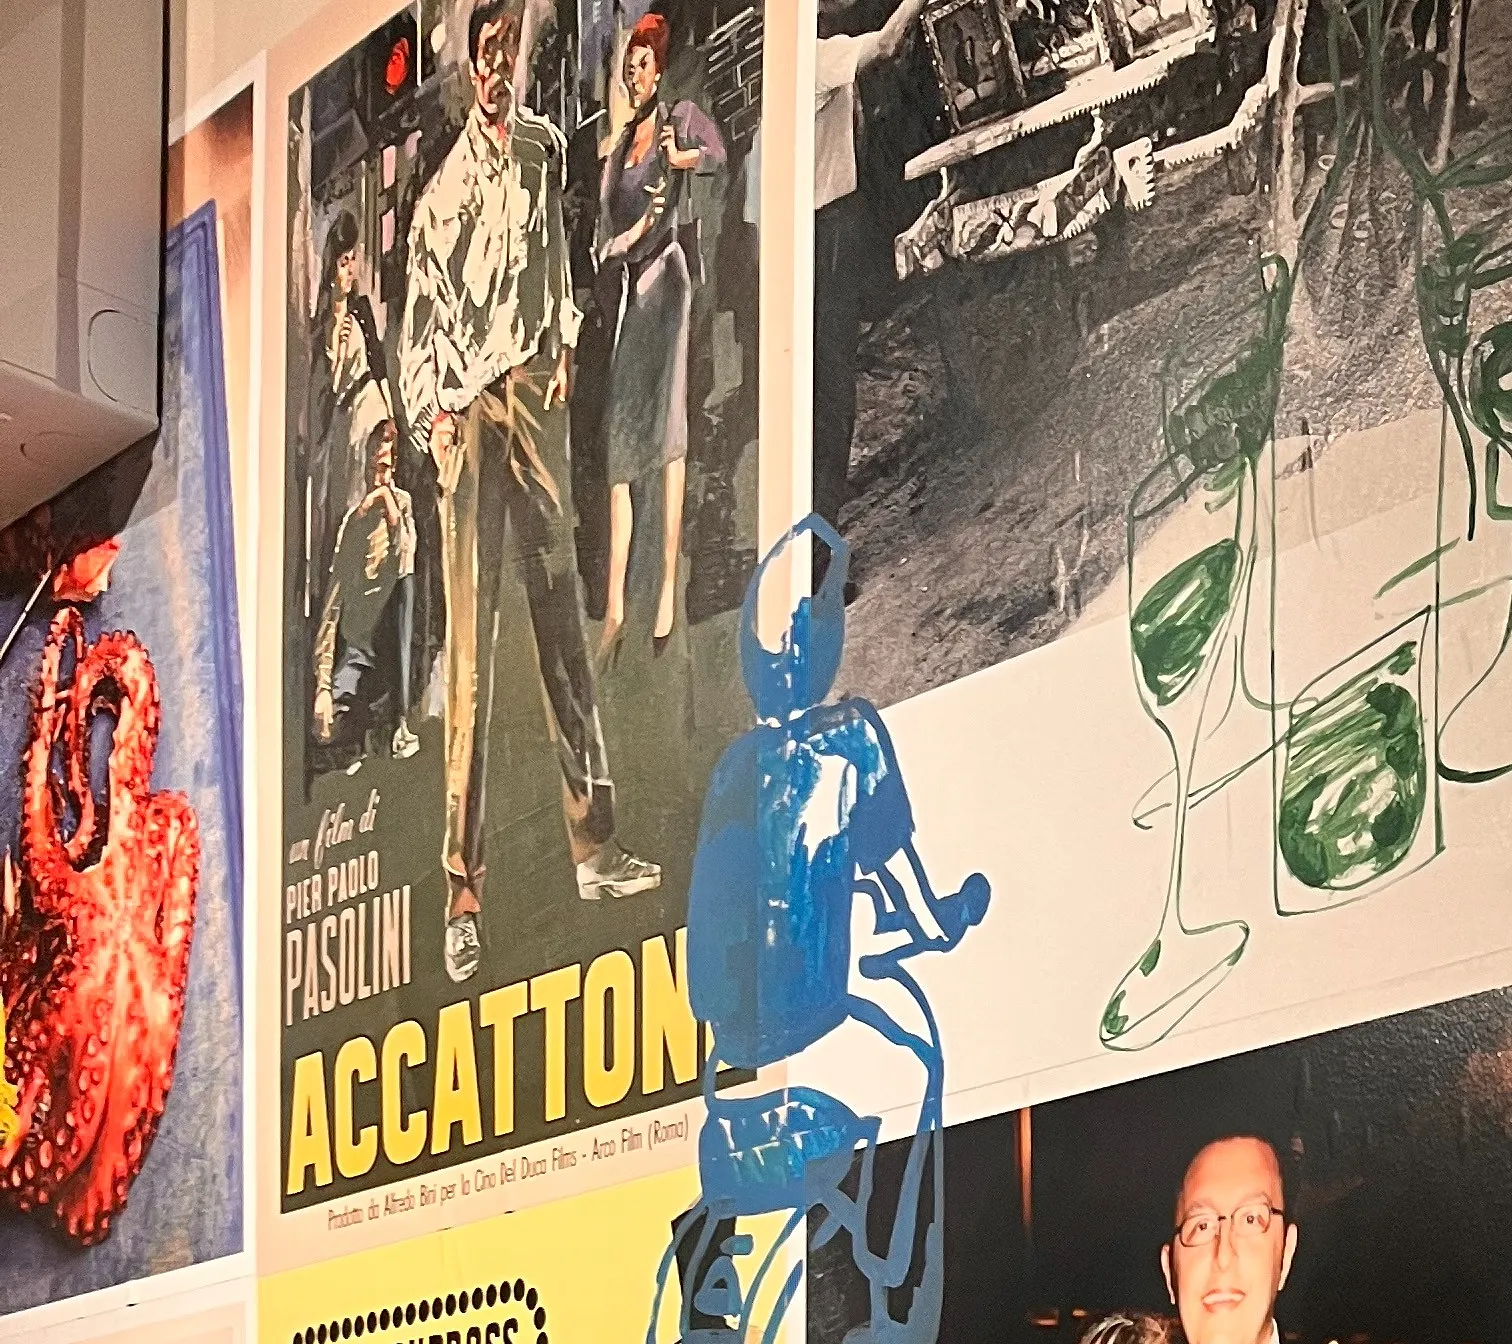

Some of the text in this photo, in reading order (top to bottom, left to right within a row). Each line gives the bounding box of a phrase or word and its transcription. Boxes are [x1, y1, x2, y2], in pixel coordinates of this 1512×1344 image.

[313, 802, 355, 870] film
[358, 788, 381, 834] di
[285, 849, 379, 924] PIER PAOLO
[285, 884, 413, 1027] PASOLINI
[286, 926, 733, 1196] ACCATTON
[440, 1182, 457, 1207] per
